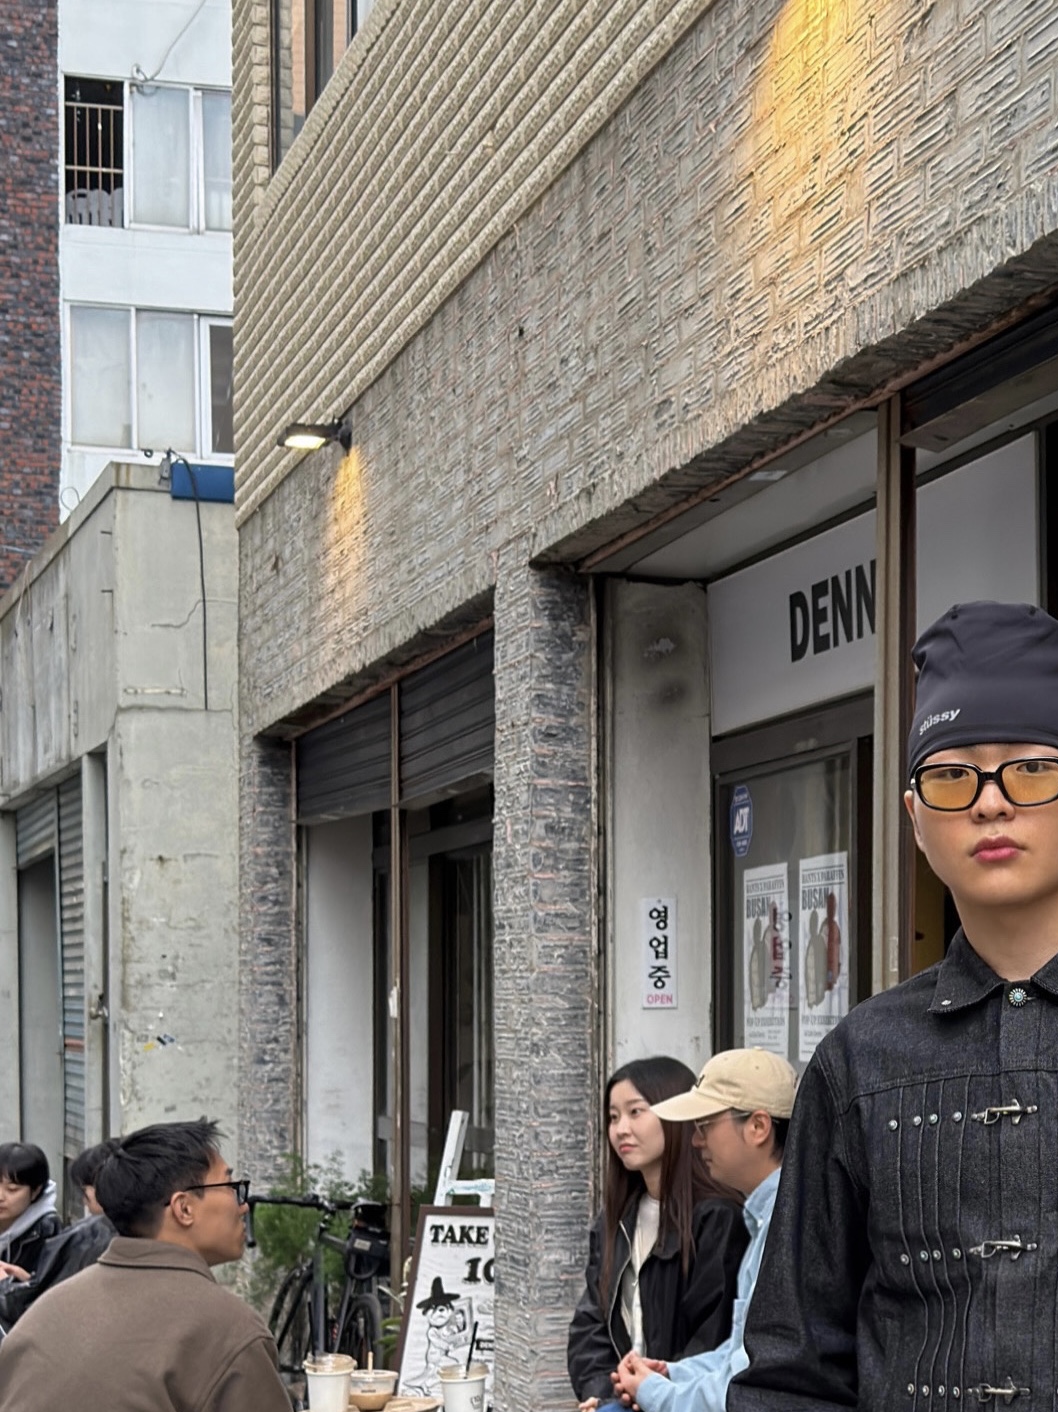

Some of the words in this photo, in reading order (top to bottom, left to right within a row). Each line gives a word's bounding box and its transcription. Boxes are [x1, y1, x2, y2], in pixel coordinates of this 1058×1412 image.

[789, 558, 877, 663] DENN
[733, 806, 750, 835] ADT
[801, 886, 829, 911] BUSAN
[648, 905, 672, 989] 영업중
[646, 993, 673, 1004] OPEN
[429, 1224, 490, 1246] TAKE
